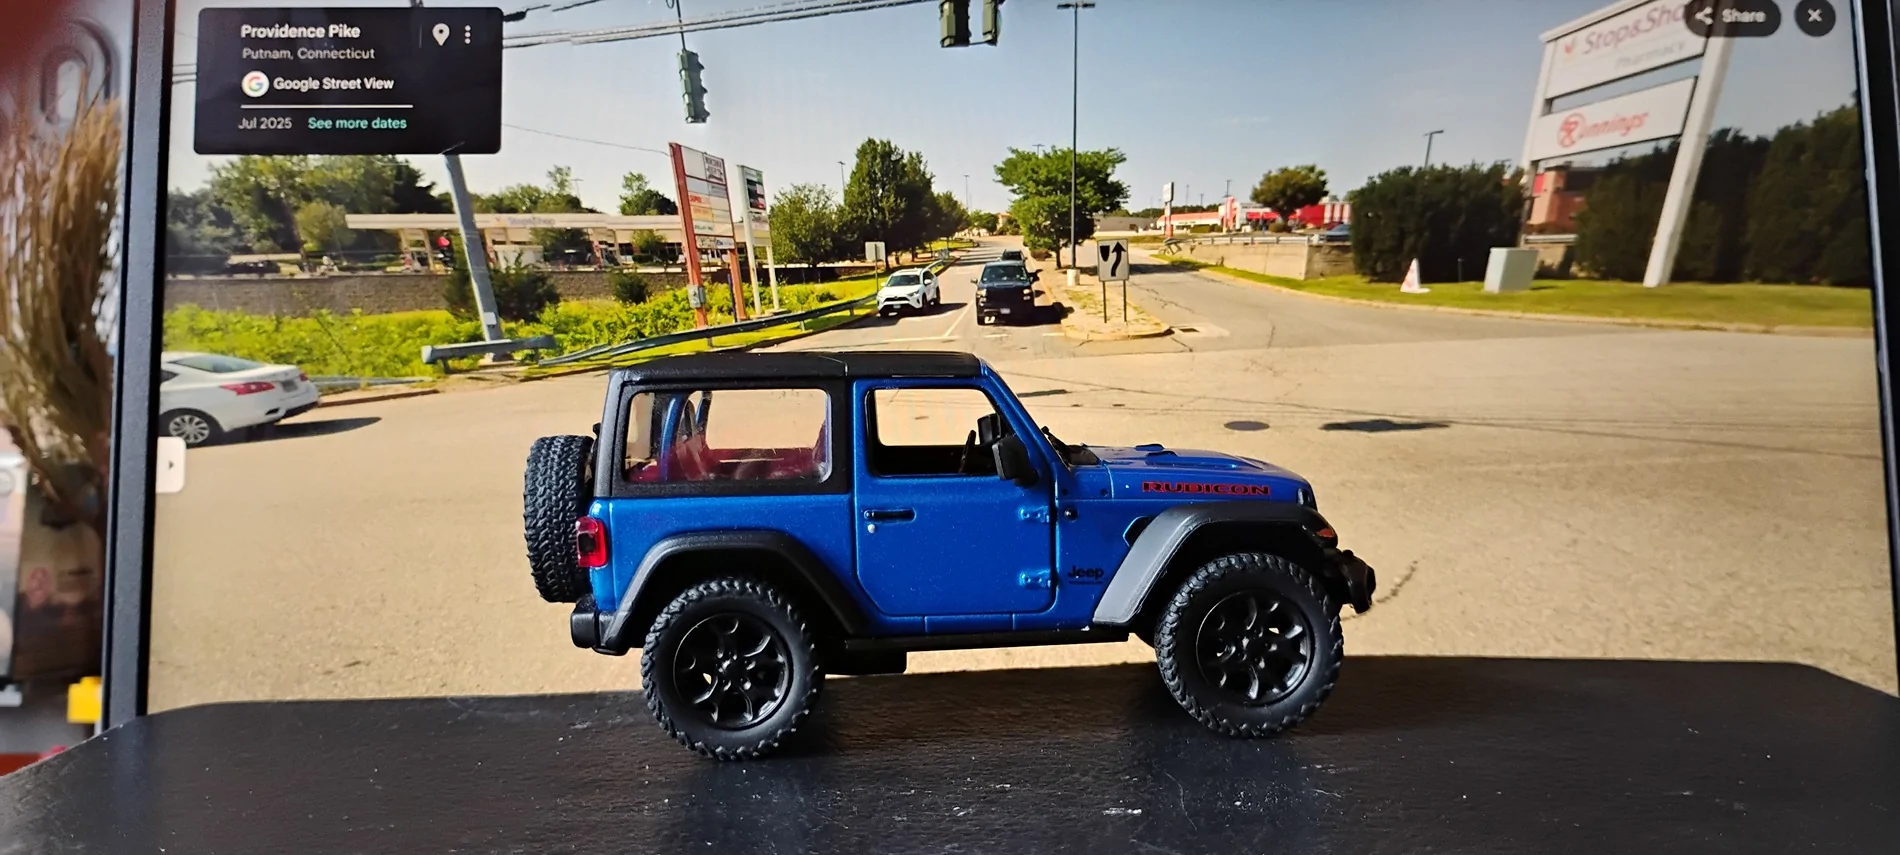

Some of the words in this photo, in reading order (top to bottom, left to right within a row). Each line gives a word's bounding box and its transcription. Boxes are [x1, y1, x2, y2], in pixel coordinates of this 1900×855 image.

[1722, 8, 1766, 23] Share
[240, 23, 325, 39] Providence
[328, 23, 361, 39] Pike
[1581, 4, 1685, 55] Stop&Sho
[242, 47, 294, 61] Putnam,
[297, 47, 375, 60] Connecticut
[273, 76, 321, 92] Google
[322, 76, 362, 90] Street
[363, 76, 395, 90] View
[238, 117, 258, 130] Jul
[260, 117, 293, 130] 2025
[308, 117, 333, 130] See
[335, 119, 369, 130] more
[371, 116, 408, 130] dates
[1141, 481, 1271, 496] RUBICON
[1067, 564, 1105, 581] Jeep
